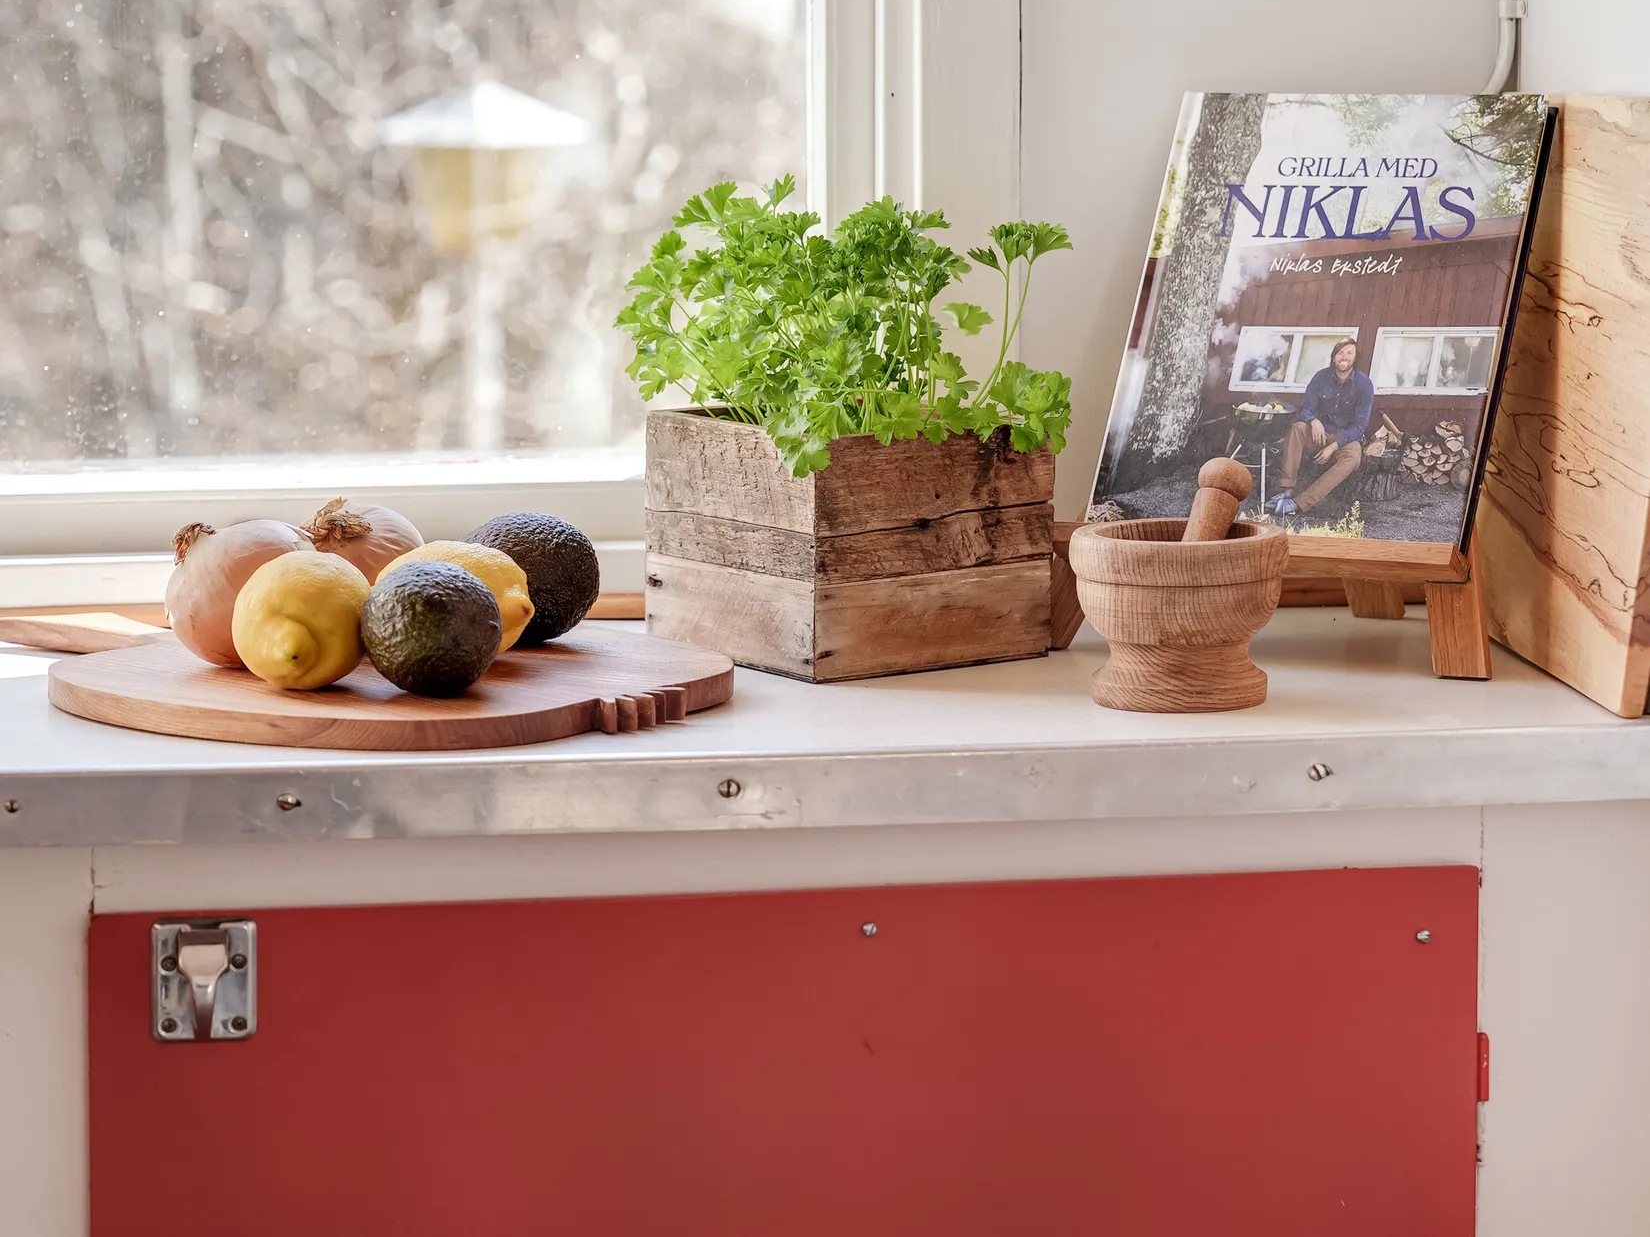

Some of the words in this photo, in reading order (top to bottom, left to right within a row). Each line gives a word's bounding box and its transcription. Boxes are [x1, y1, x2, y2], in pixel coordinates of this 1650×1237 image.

[1278, 156, 1370, 178] GRILLA
[1375, 157, 1438, 178] MED
[1215, 184, 1476, 242] NIKLAS
[1270, 253, 1323, 273] Niklas
